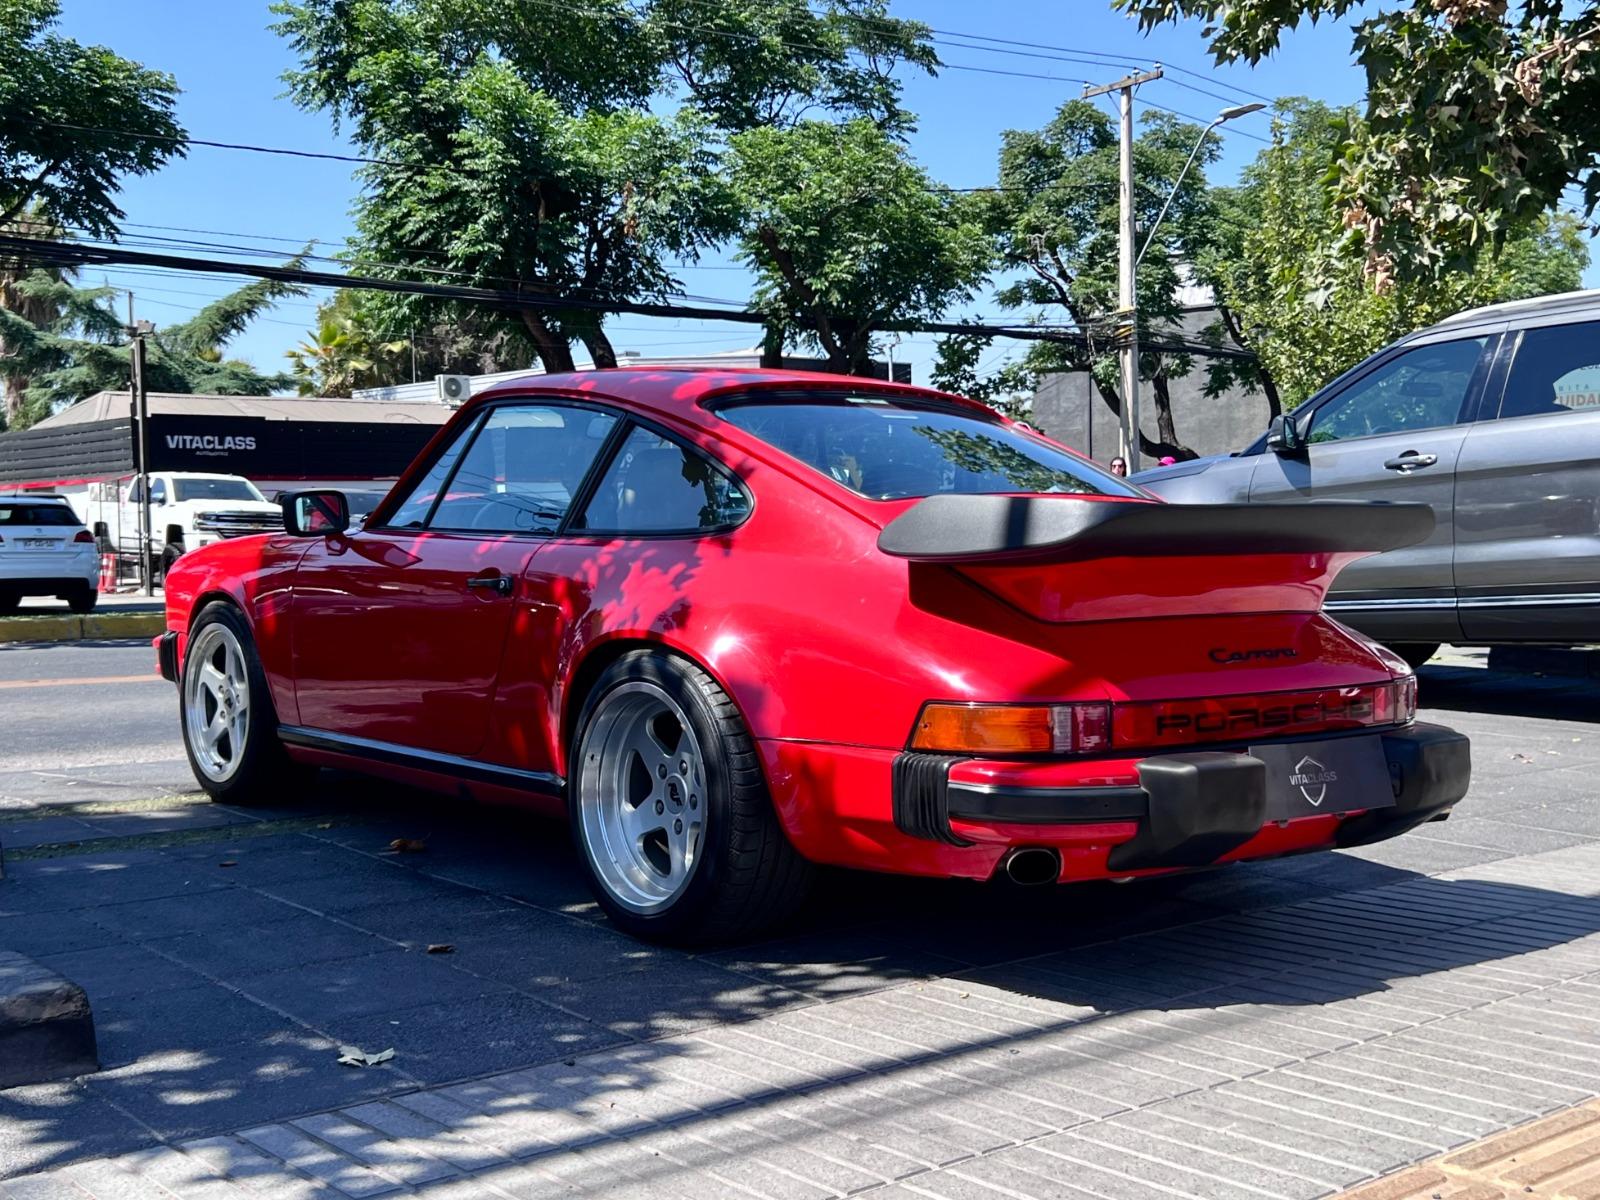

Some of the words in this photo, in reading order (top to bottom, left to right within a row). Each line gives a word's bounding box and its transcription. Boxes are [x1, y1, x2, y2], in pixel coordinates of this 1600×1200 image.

[166, 434, 257, 450] VITACLASS
[1208, 648, 1298, 664] Carrera
[1156, 696, 1373, 737] PORSCHE
[1289, 771, 1337, 786] VITACLASS
